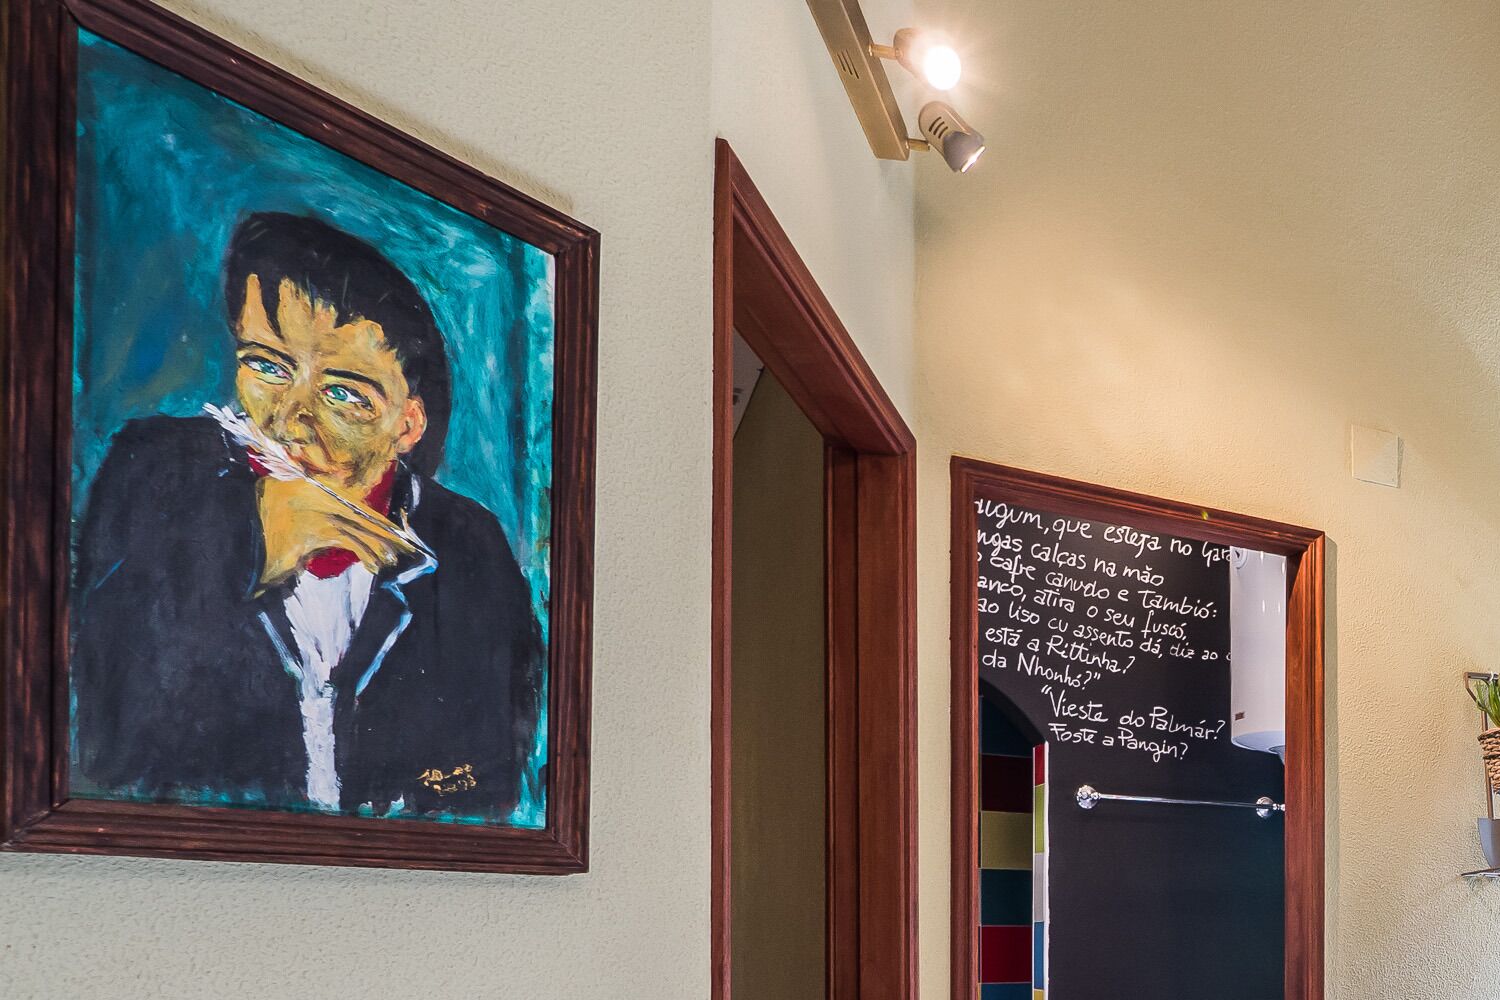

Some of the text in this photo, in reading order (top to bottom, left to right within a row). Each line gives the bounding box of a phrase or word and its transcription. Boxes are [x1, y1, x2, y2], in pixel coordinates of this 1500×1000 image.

[1052, 518, 1093, 541] que
[1170, 537, 1193, 556] no
[1030, 542, 1087, 569] calças
[1093, 557, 1118, 578] na
[1122, 564, 1165, 587] mão
[1045, 571, 1110, 600] canudo
[1117, 588, 1130, 602] e
[1033, 588, 1076, 613] atira
[1086, 605, 1099, 618] o
[1103, 608, 1136, 628] seu
[985, 627, 1024, 647] está
[1026, 638, 1041, 653] a
[1008, 600, 1041, 625] liso
[1047, 617, 1069, 633] cu
[1072, 624, 1134, 649] assento
[1139, 637, 1164, 659] dá,
[1169, 640, 1196, 659] diz
[1201, 649, 1219, 661] ao
[982, 649, 1007, 669] da
[1118, 710, 1146, 729] do
[1047, 722, 1190, 763] Foste a Pangin?
